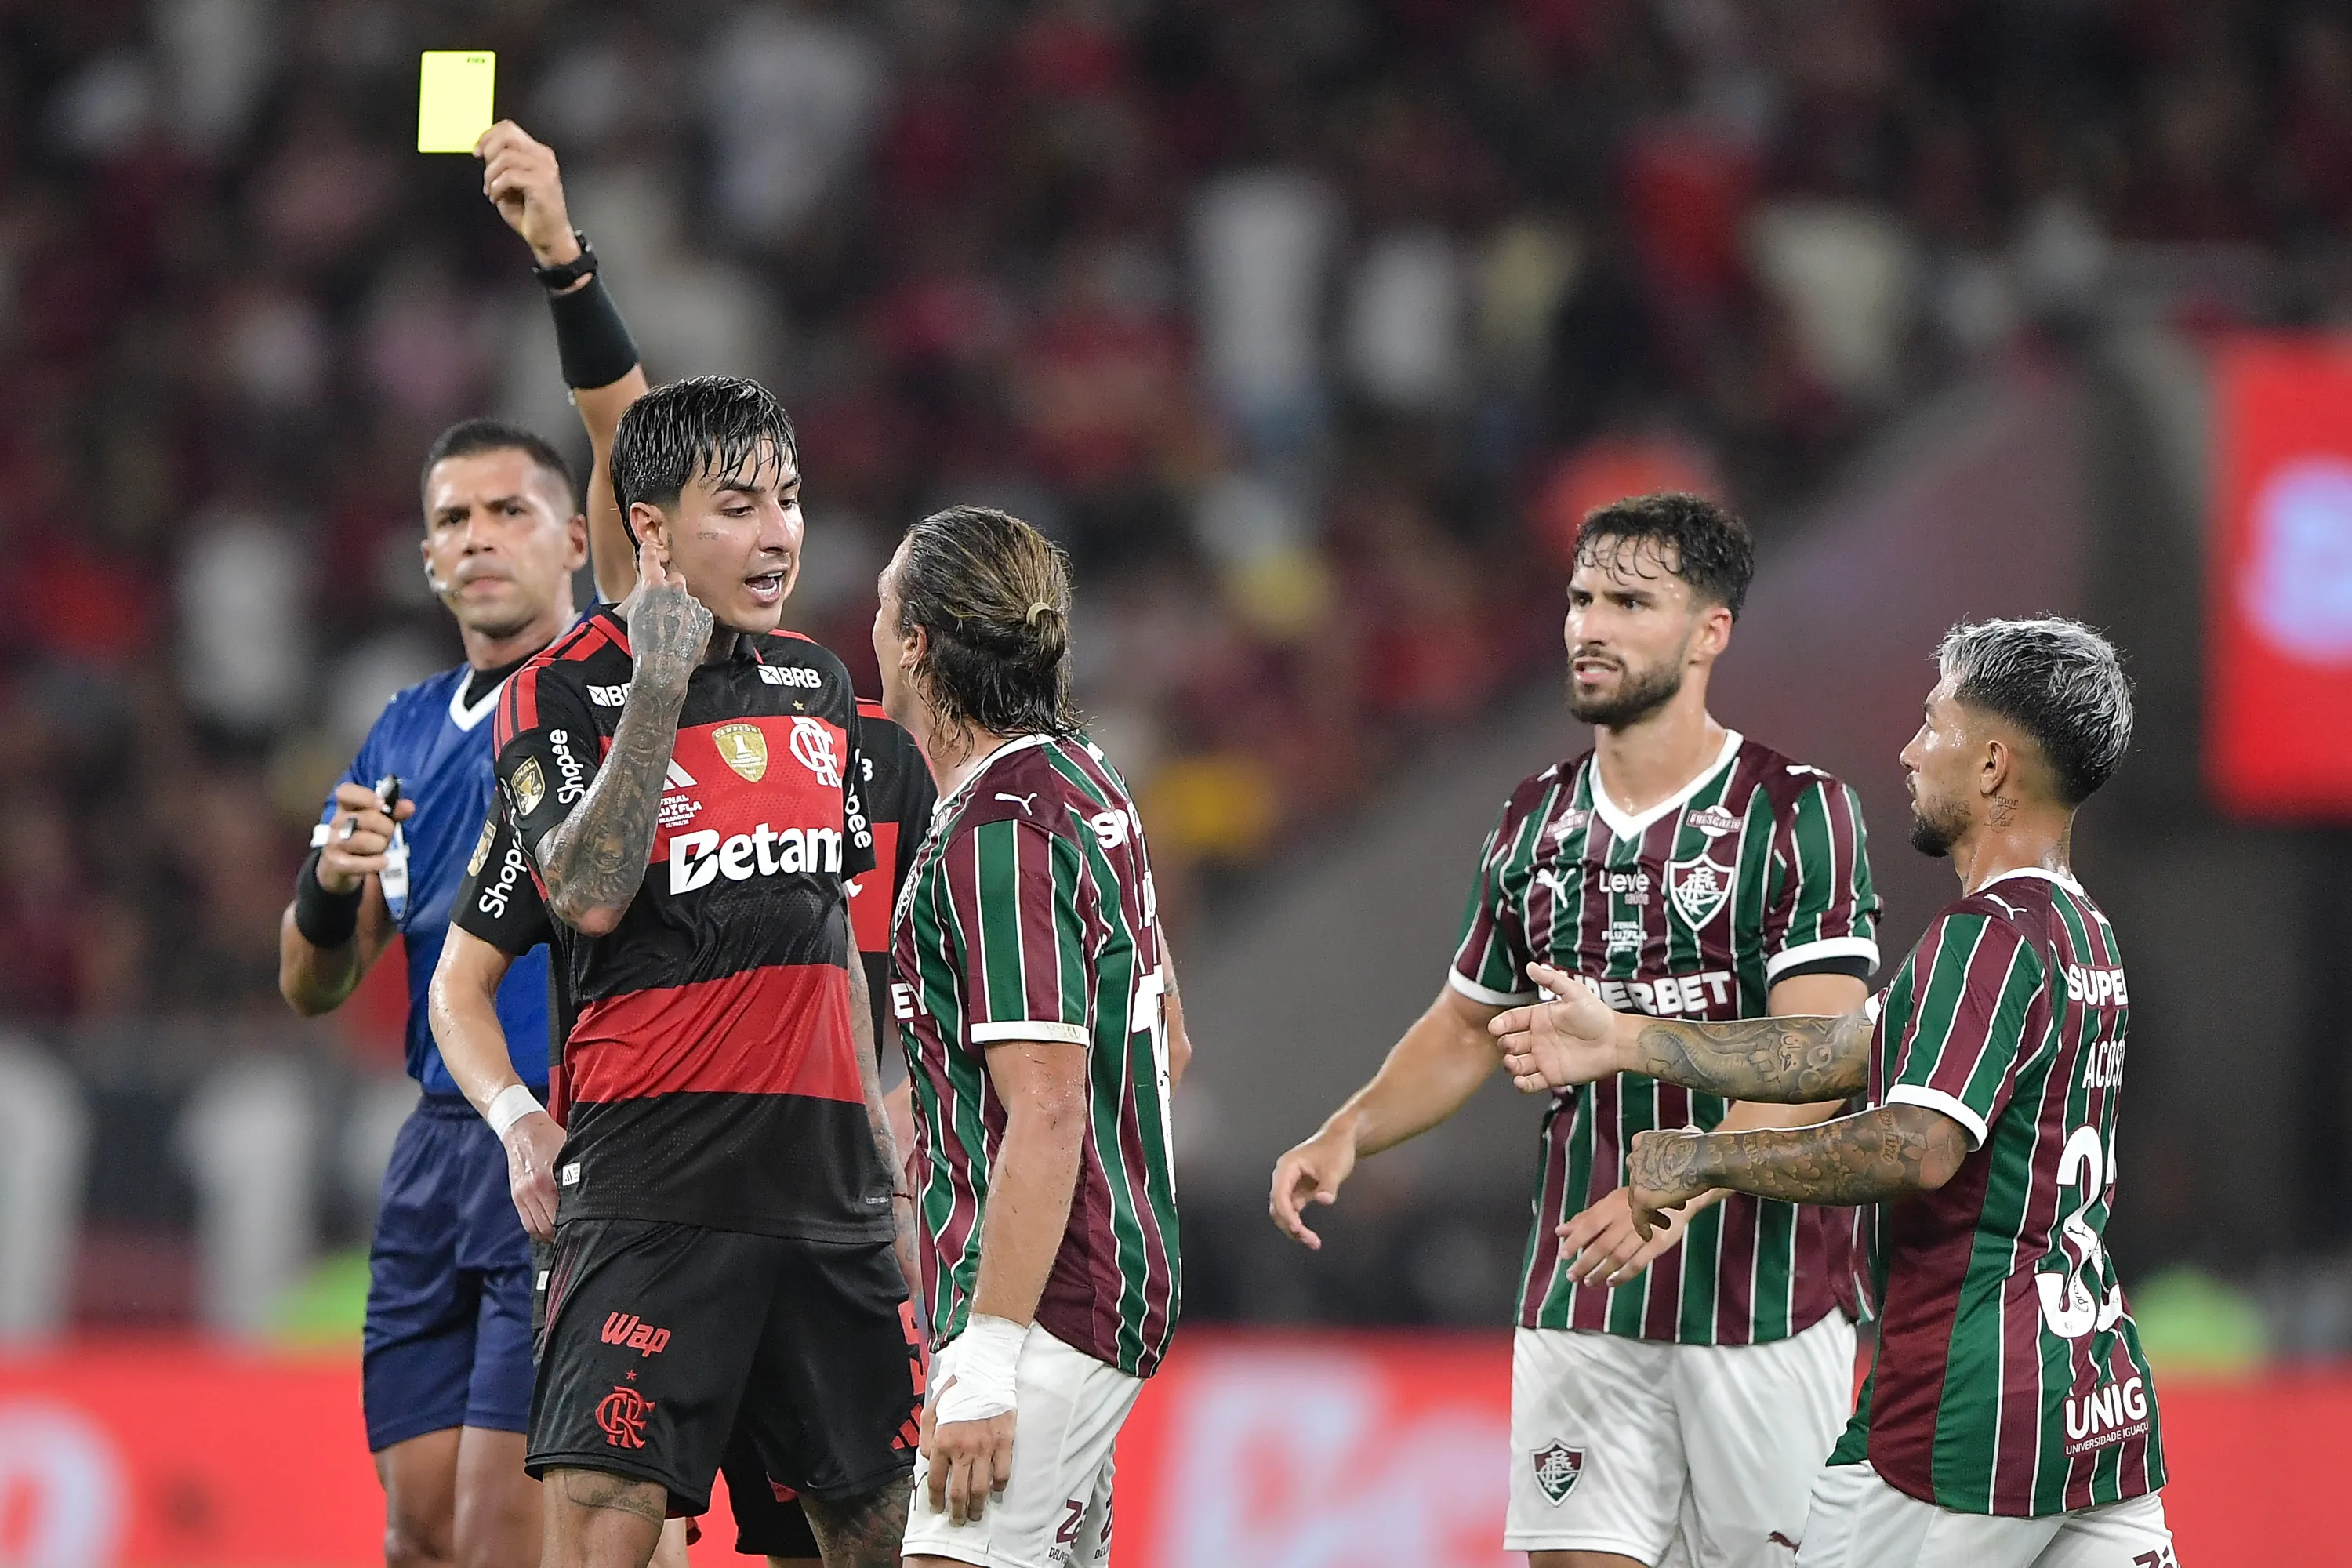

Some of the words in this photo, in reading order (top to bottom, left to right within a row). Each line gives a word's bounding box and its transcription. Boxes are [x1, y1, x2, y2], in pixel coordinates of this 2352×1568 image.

[777, 666, 822, 688] BRB
[549, 728, 586, 805] Shopee
[1599, 869, 1650, 894] Leve
[601, 1312, 671, 1358] Wap
[2065, 1377, 2147, 1440] UNIG
[2065, 1429, 2122, 1455] UNIVERSIDADE
[2122, 1420, 2149, 1439] IGUAÇU
